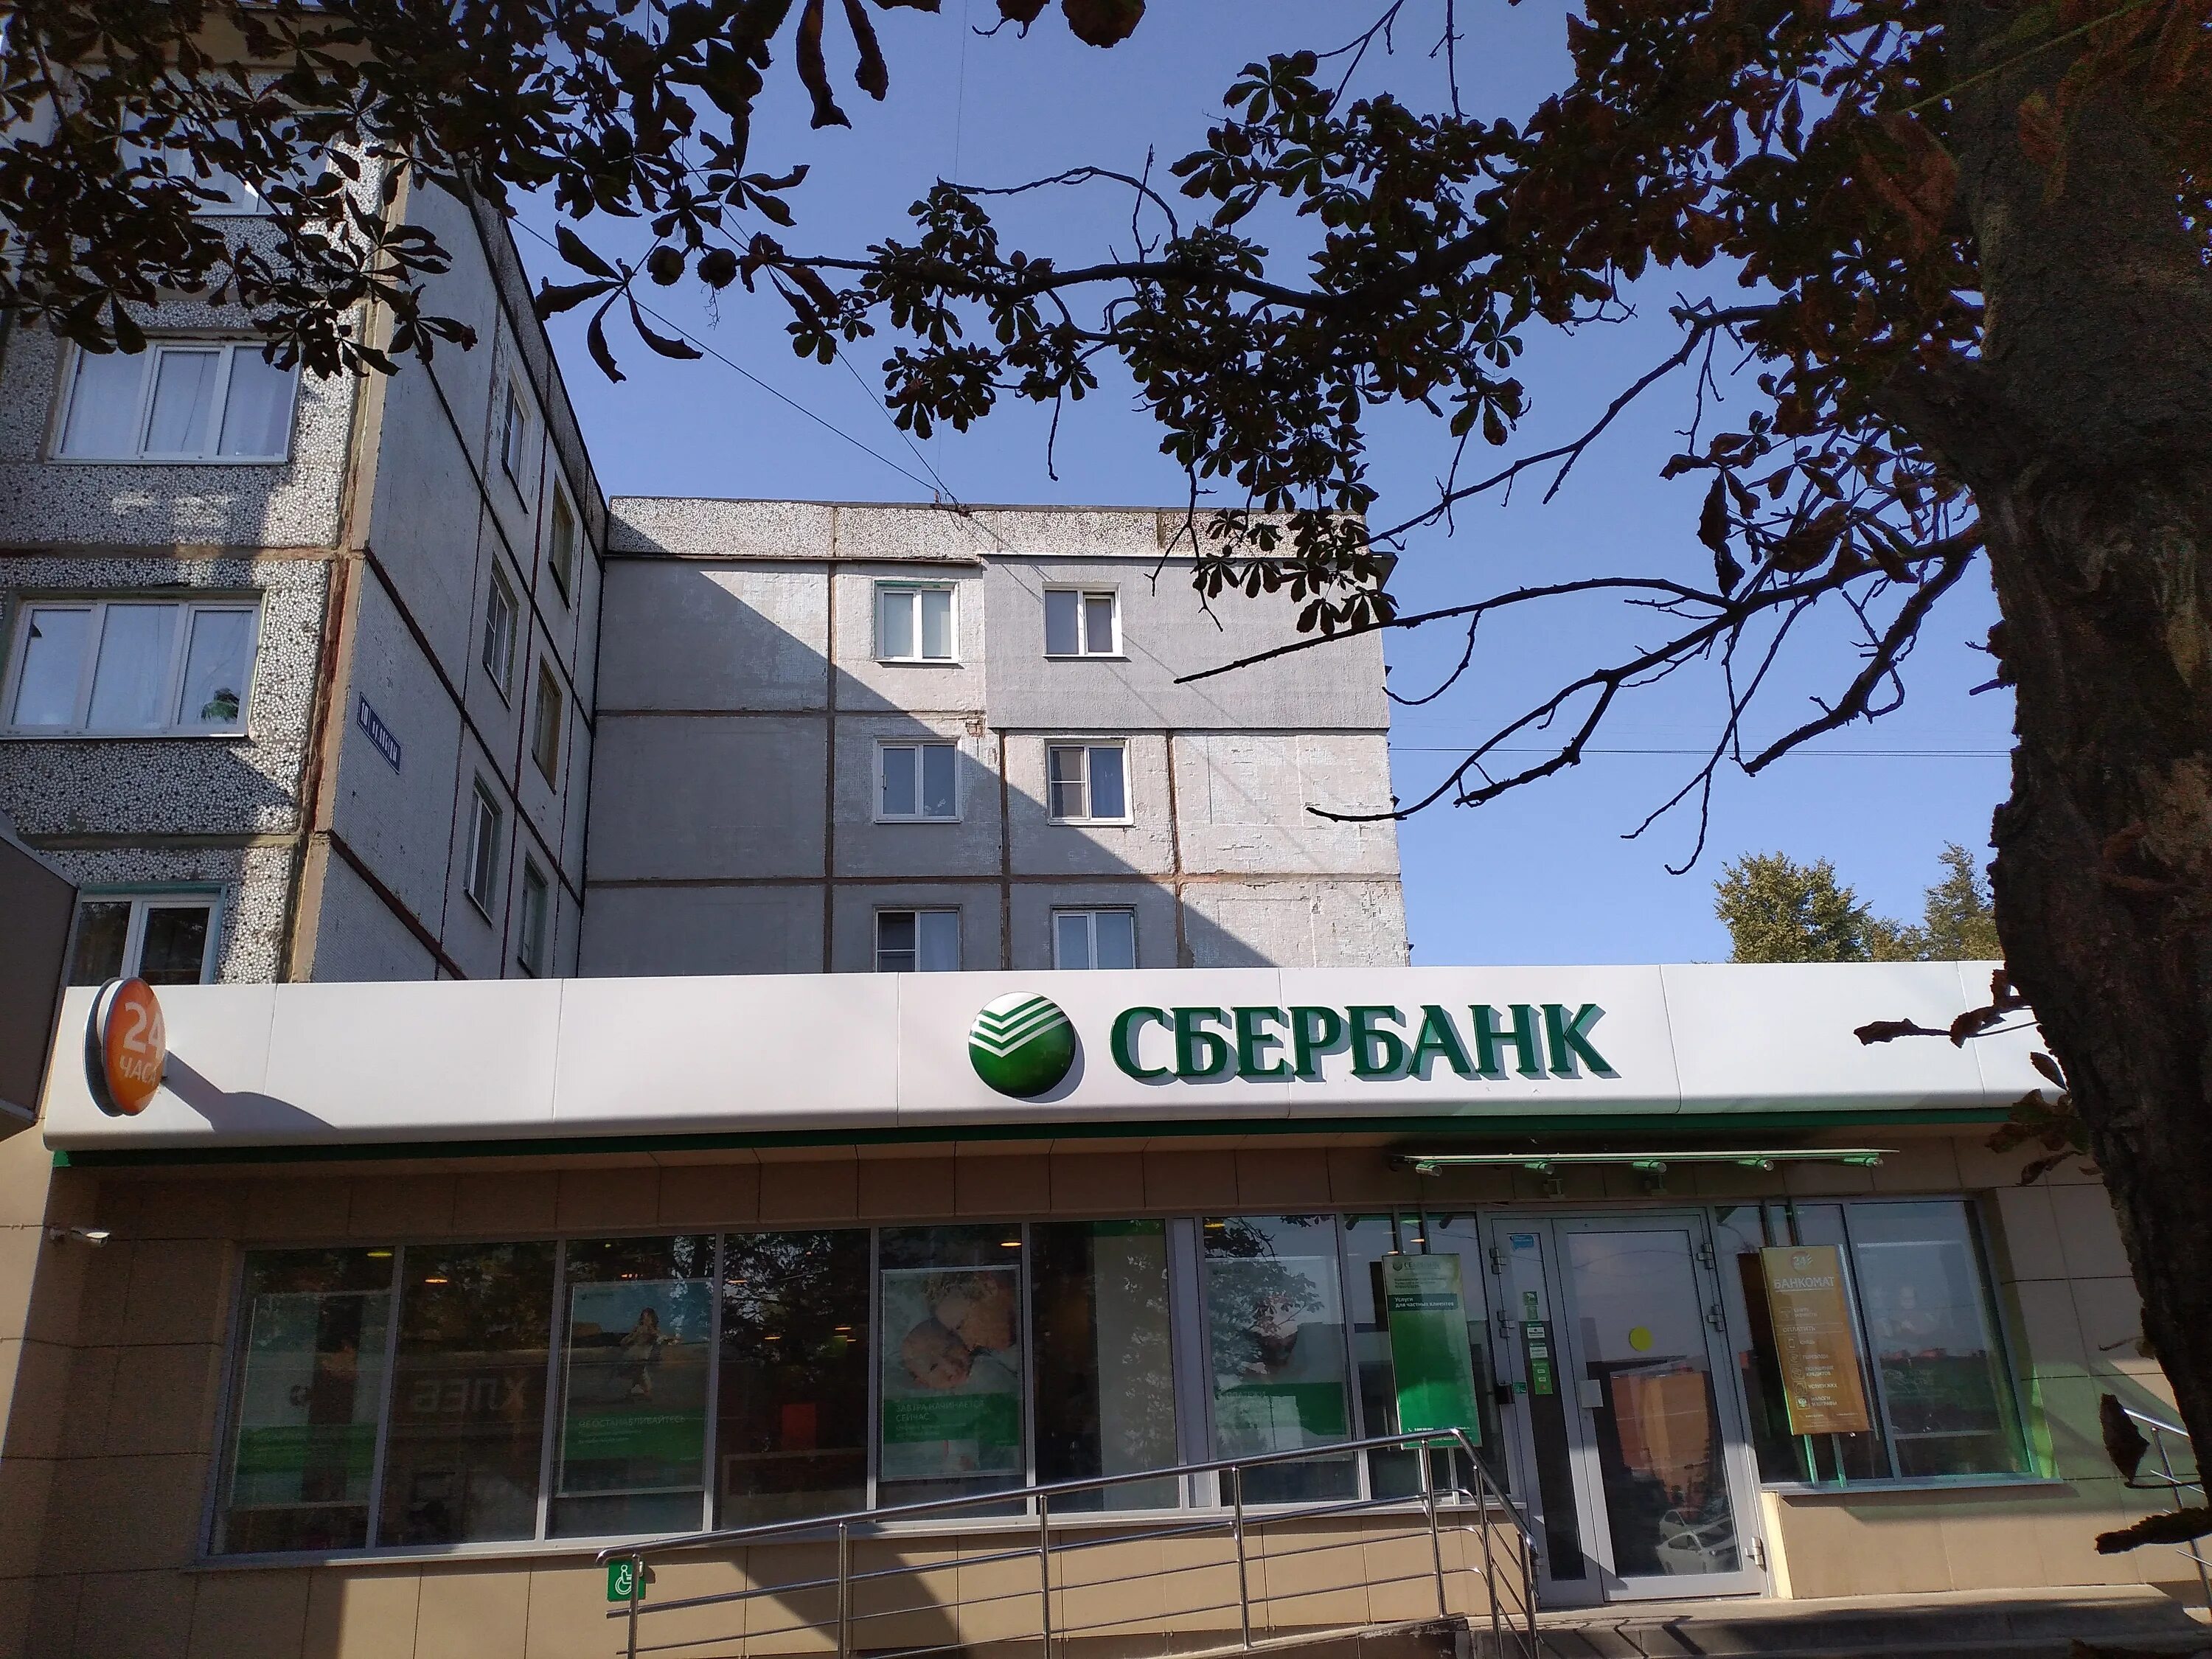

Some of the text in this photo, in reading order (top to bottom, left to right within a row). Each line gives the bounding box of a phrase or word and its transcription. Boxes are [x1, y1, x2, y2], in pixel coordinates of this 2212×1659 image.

[361, 701, 369, 726] 10
[122, 1001, 166, 1064] 24
[1109, 1003, 1614, 1079] СБЕРБАНК
[119, 1054, 157, 1088] ЧАСА
[1773, 1276, 1834, 1289] БАНКОМАТ
[895, 1399, 985, 1413] ЗАВТРА НАЧИНАЕТСЯ
[577, 1414, 686, 1428] НЕ ОСТАНАВЛИВАЙТЕСЬ
[895, 1412, 930, 1422] СЕЙЧАС
